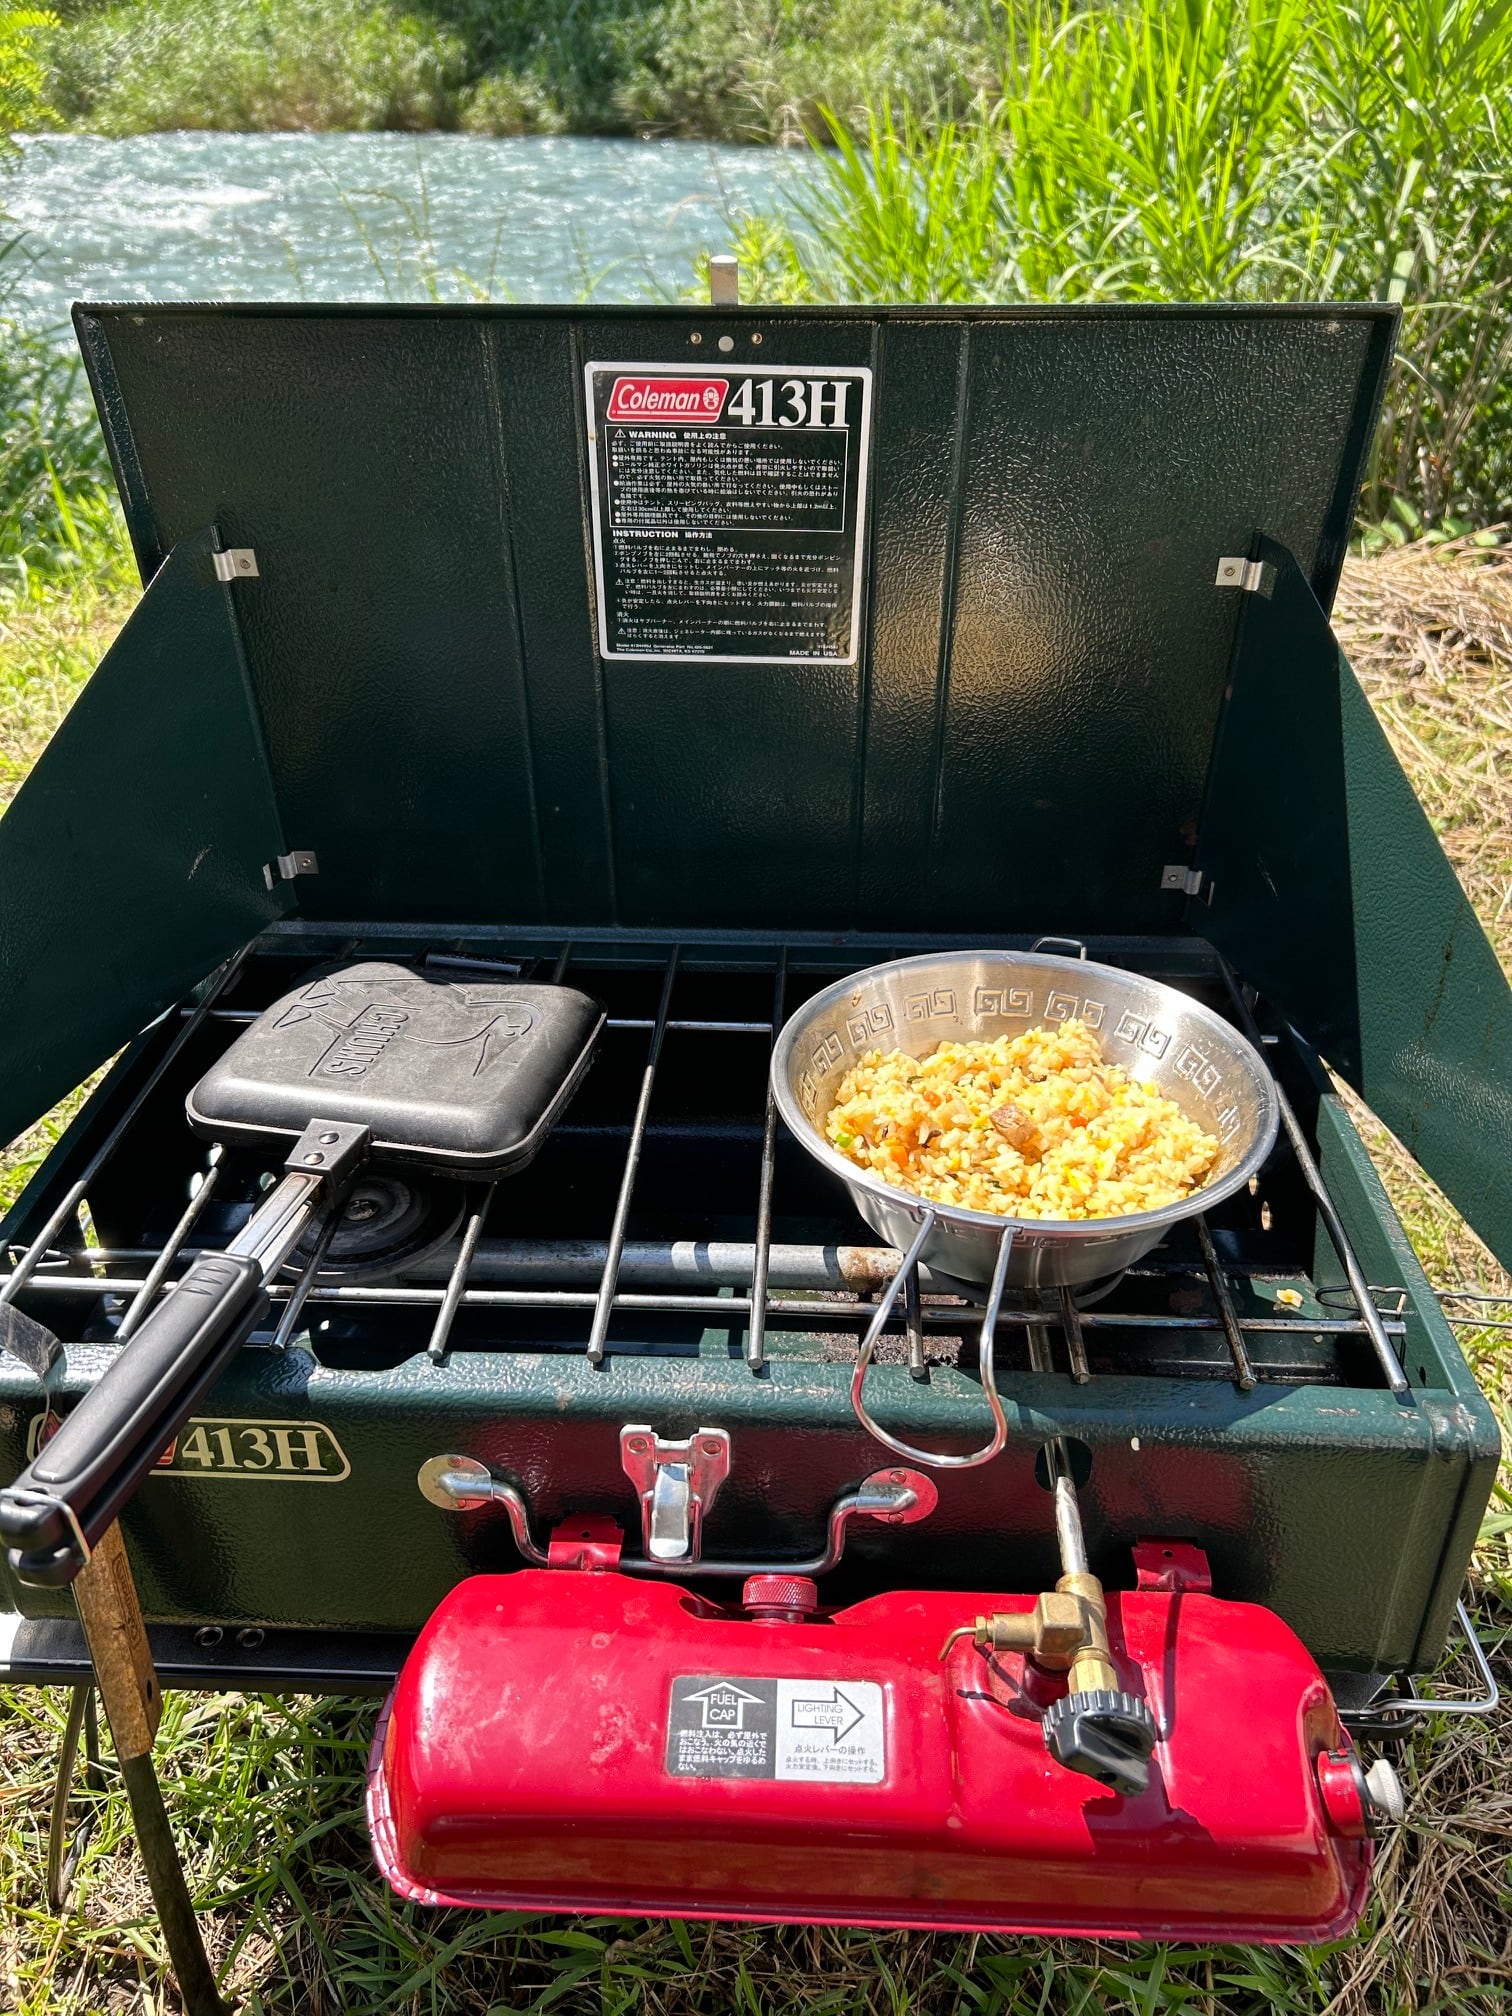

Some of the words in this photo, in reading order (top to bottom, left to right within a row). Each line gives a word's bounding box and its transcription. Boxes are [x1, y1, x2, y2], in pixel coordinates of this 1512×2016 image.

[618, 384, 700, 410] Coleman
[728, 379, 852, 427] 413H
[629, 430, 676, 439] WARNING
[612, 530, 678, 538] INSTRUCTION
[324, 1011, 409, 1076] CHUMS
[181, 1426, 328, 1471] 413H
[710, 1693, 738, 1706] FUEL
[710, 1708, 736, 1720] CAP
[798, 1703, 844, 1713] LIGHTING
[814, 1716, 844, 1726] LEVER
